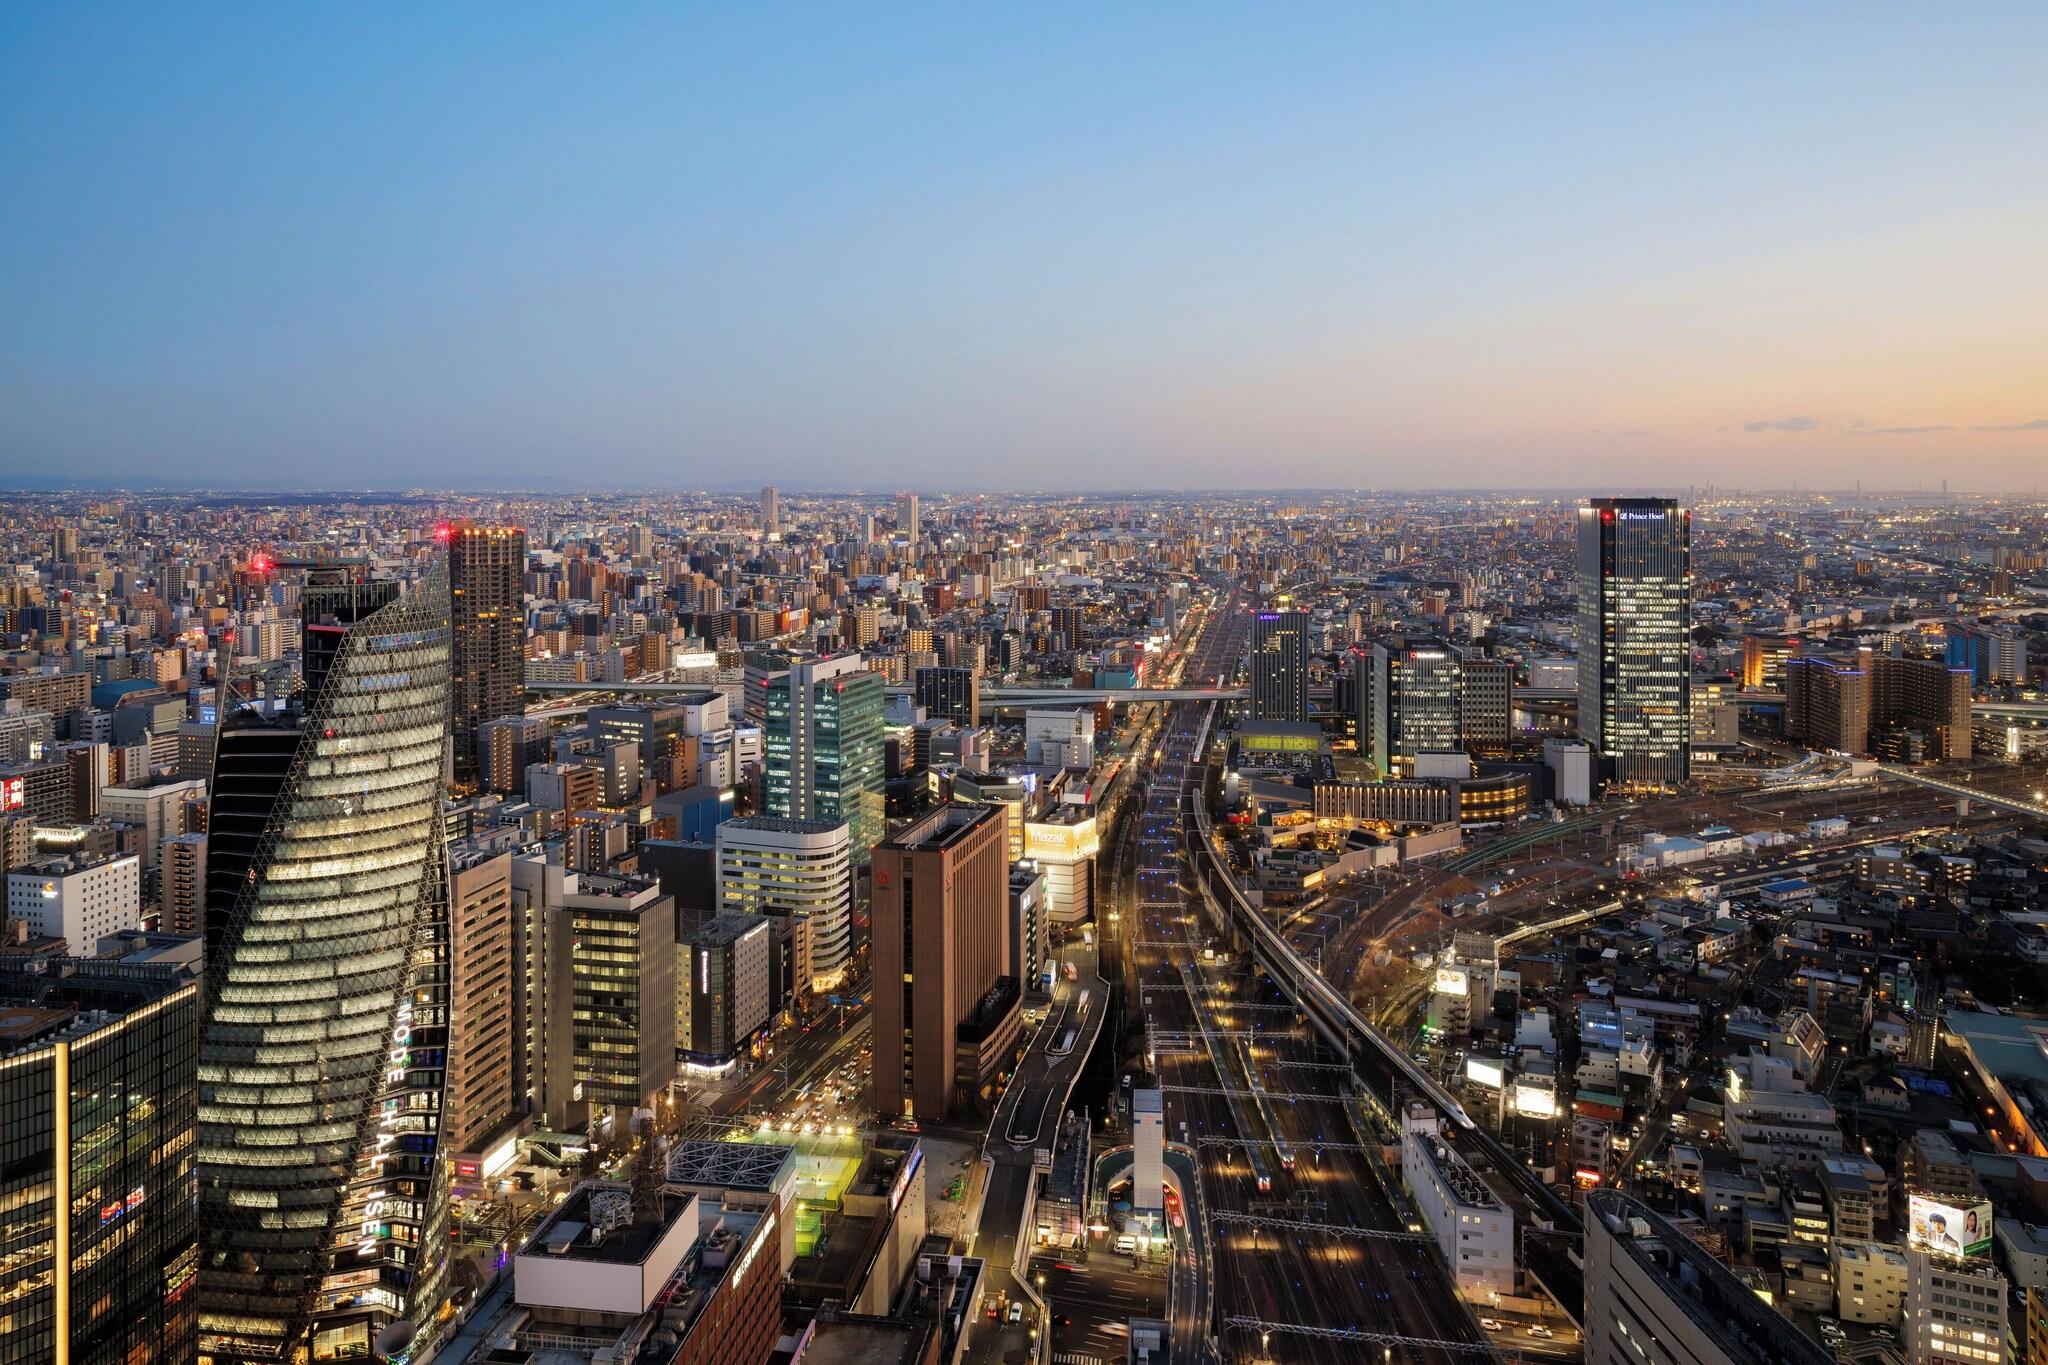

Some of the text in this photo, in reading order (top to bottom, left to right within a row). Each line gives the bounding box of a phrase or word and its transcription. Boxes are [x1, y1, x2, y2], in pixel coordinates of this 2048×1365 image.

[1031, 831, 1064, 843] Mazak
[358, 1004, 412, 1255] MODE HAL ISEN
